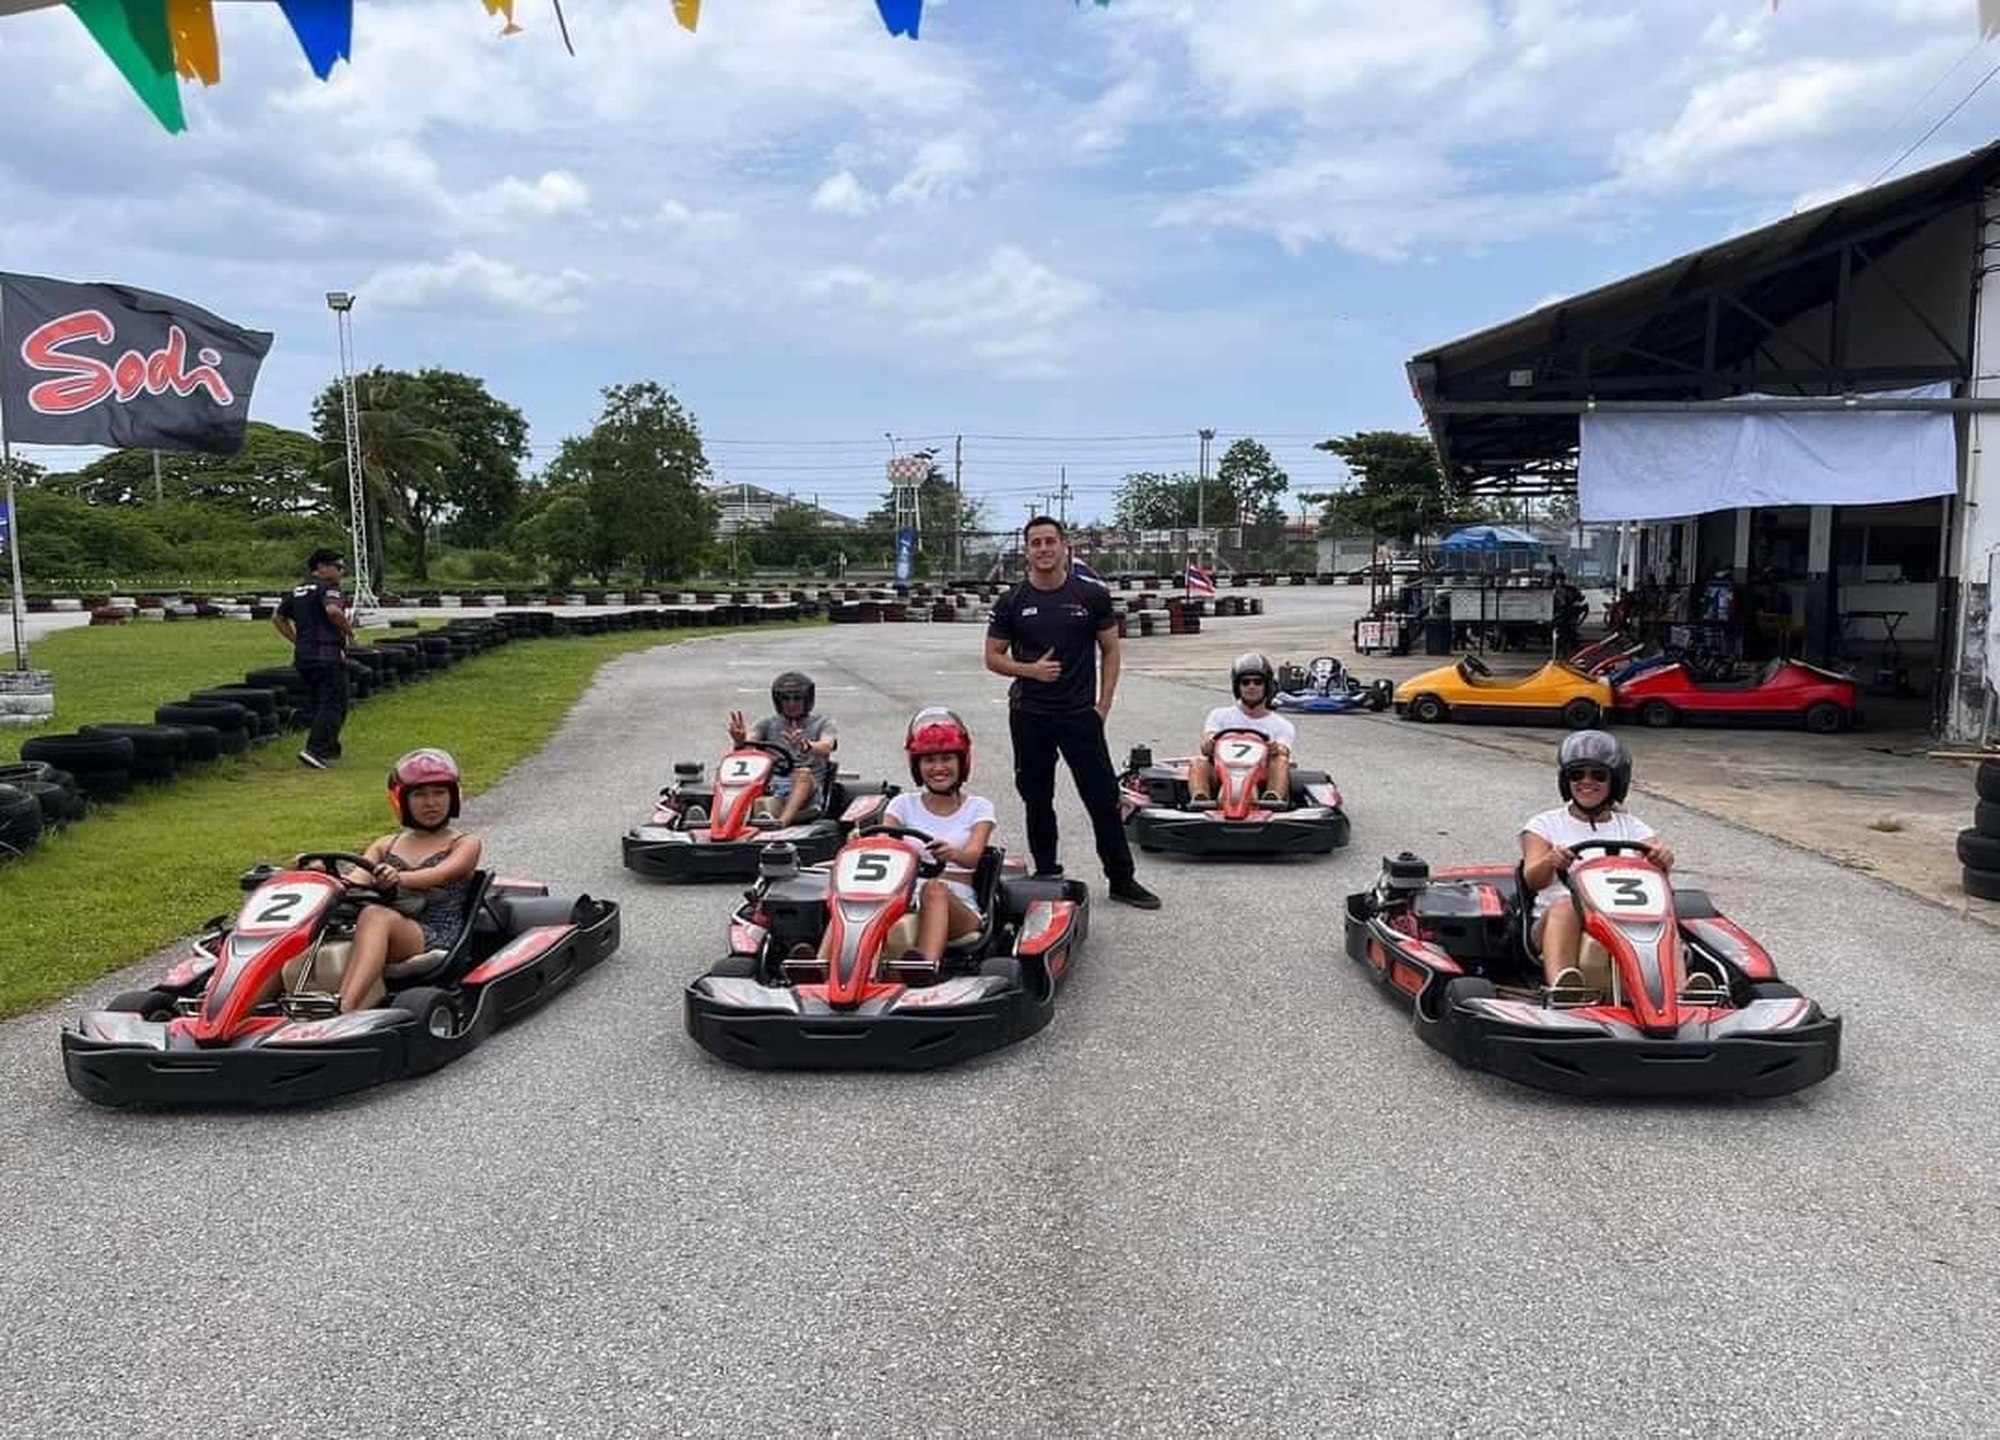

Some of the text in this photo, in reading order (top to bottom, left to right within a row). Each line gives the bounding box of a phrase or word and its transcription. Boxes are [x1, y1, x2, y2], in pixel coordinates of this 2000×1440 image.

[21, 310, 233, 413] Sodi
[1230, 744, 1252, 758] 7
[732, 761, 750, 776] 1
[853, 853, 891, 882] 5
[1605, 877, 1648, 906] 3
[255, 893, 303, 922] 2
